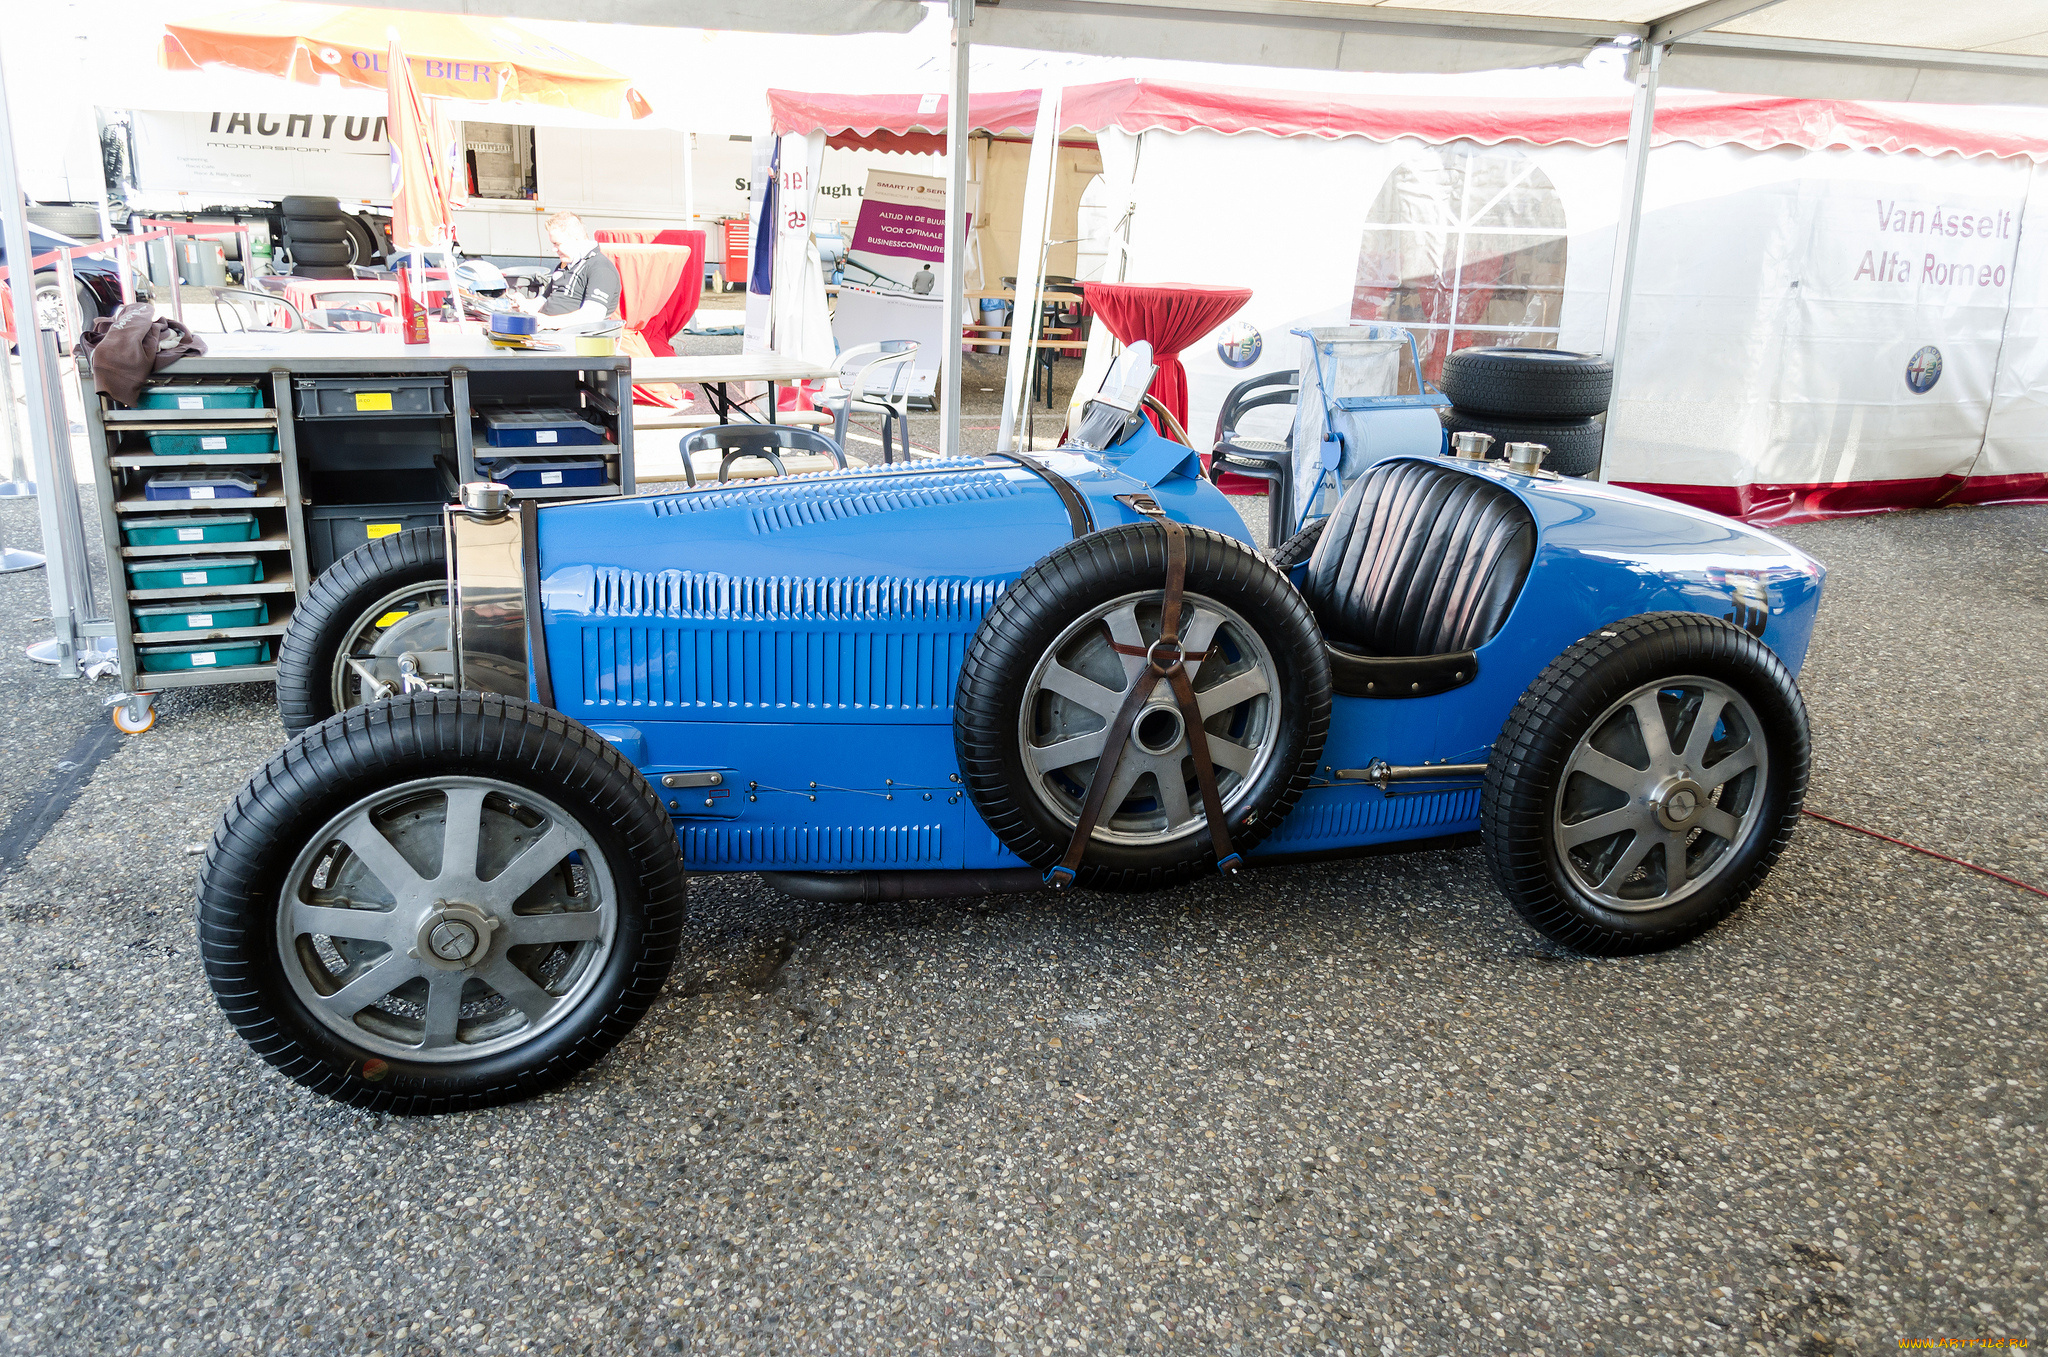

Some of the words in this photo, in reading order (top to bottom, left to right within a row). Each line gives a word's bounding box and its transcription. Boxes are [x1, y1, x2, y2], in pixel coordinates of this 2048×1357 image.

[425, 58, 492, 84] BIER
[876, 181, 906, 190] SMART
[879, 211, 904, 221] ALTIJD
[914, 214, 926, 223] DE
[1876, 199, 1926, 234] Van
[1929, 205, 2011, 240] Asselt
[880, 225, 904, 234] VOOR
[905, 228, 944, 240] OPTIMALE
[1853, 249, 1912, 283] Alfa
[1921, 252, 2007, 288] Romeo
